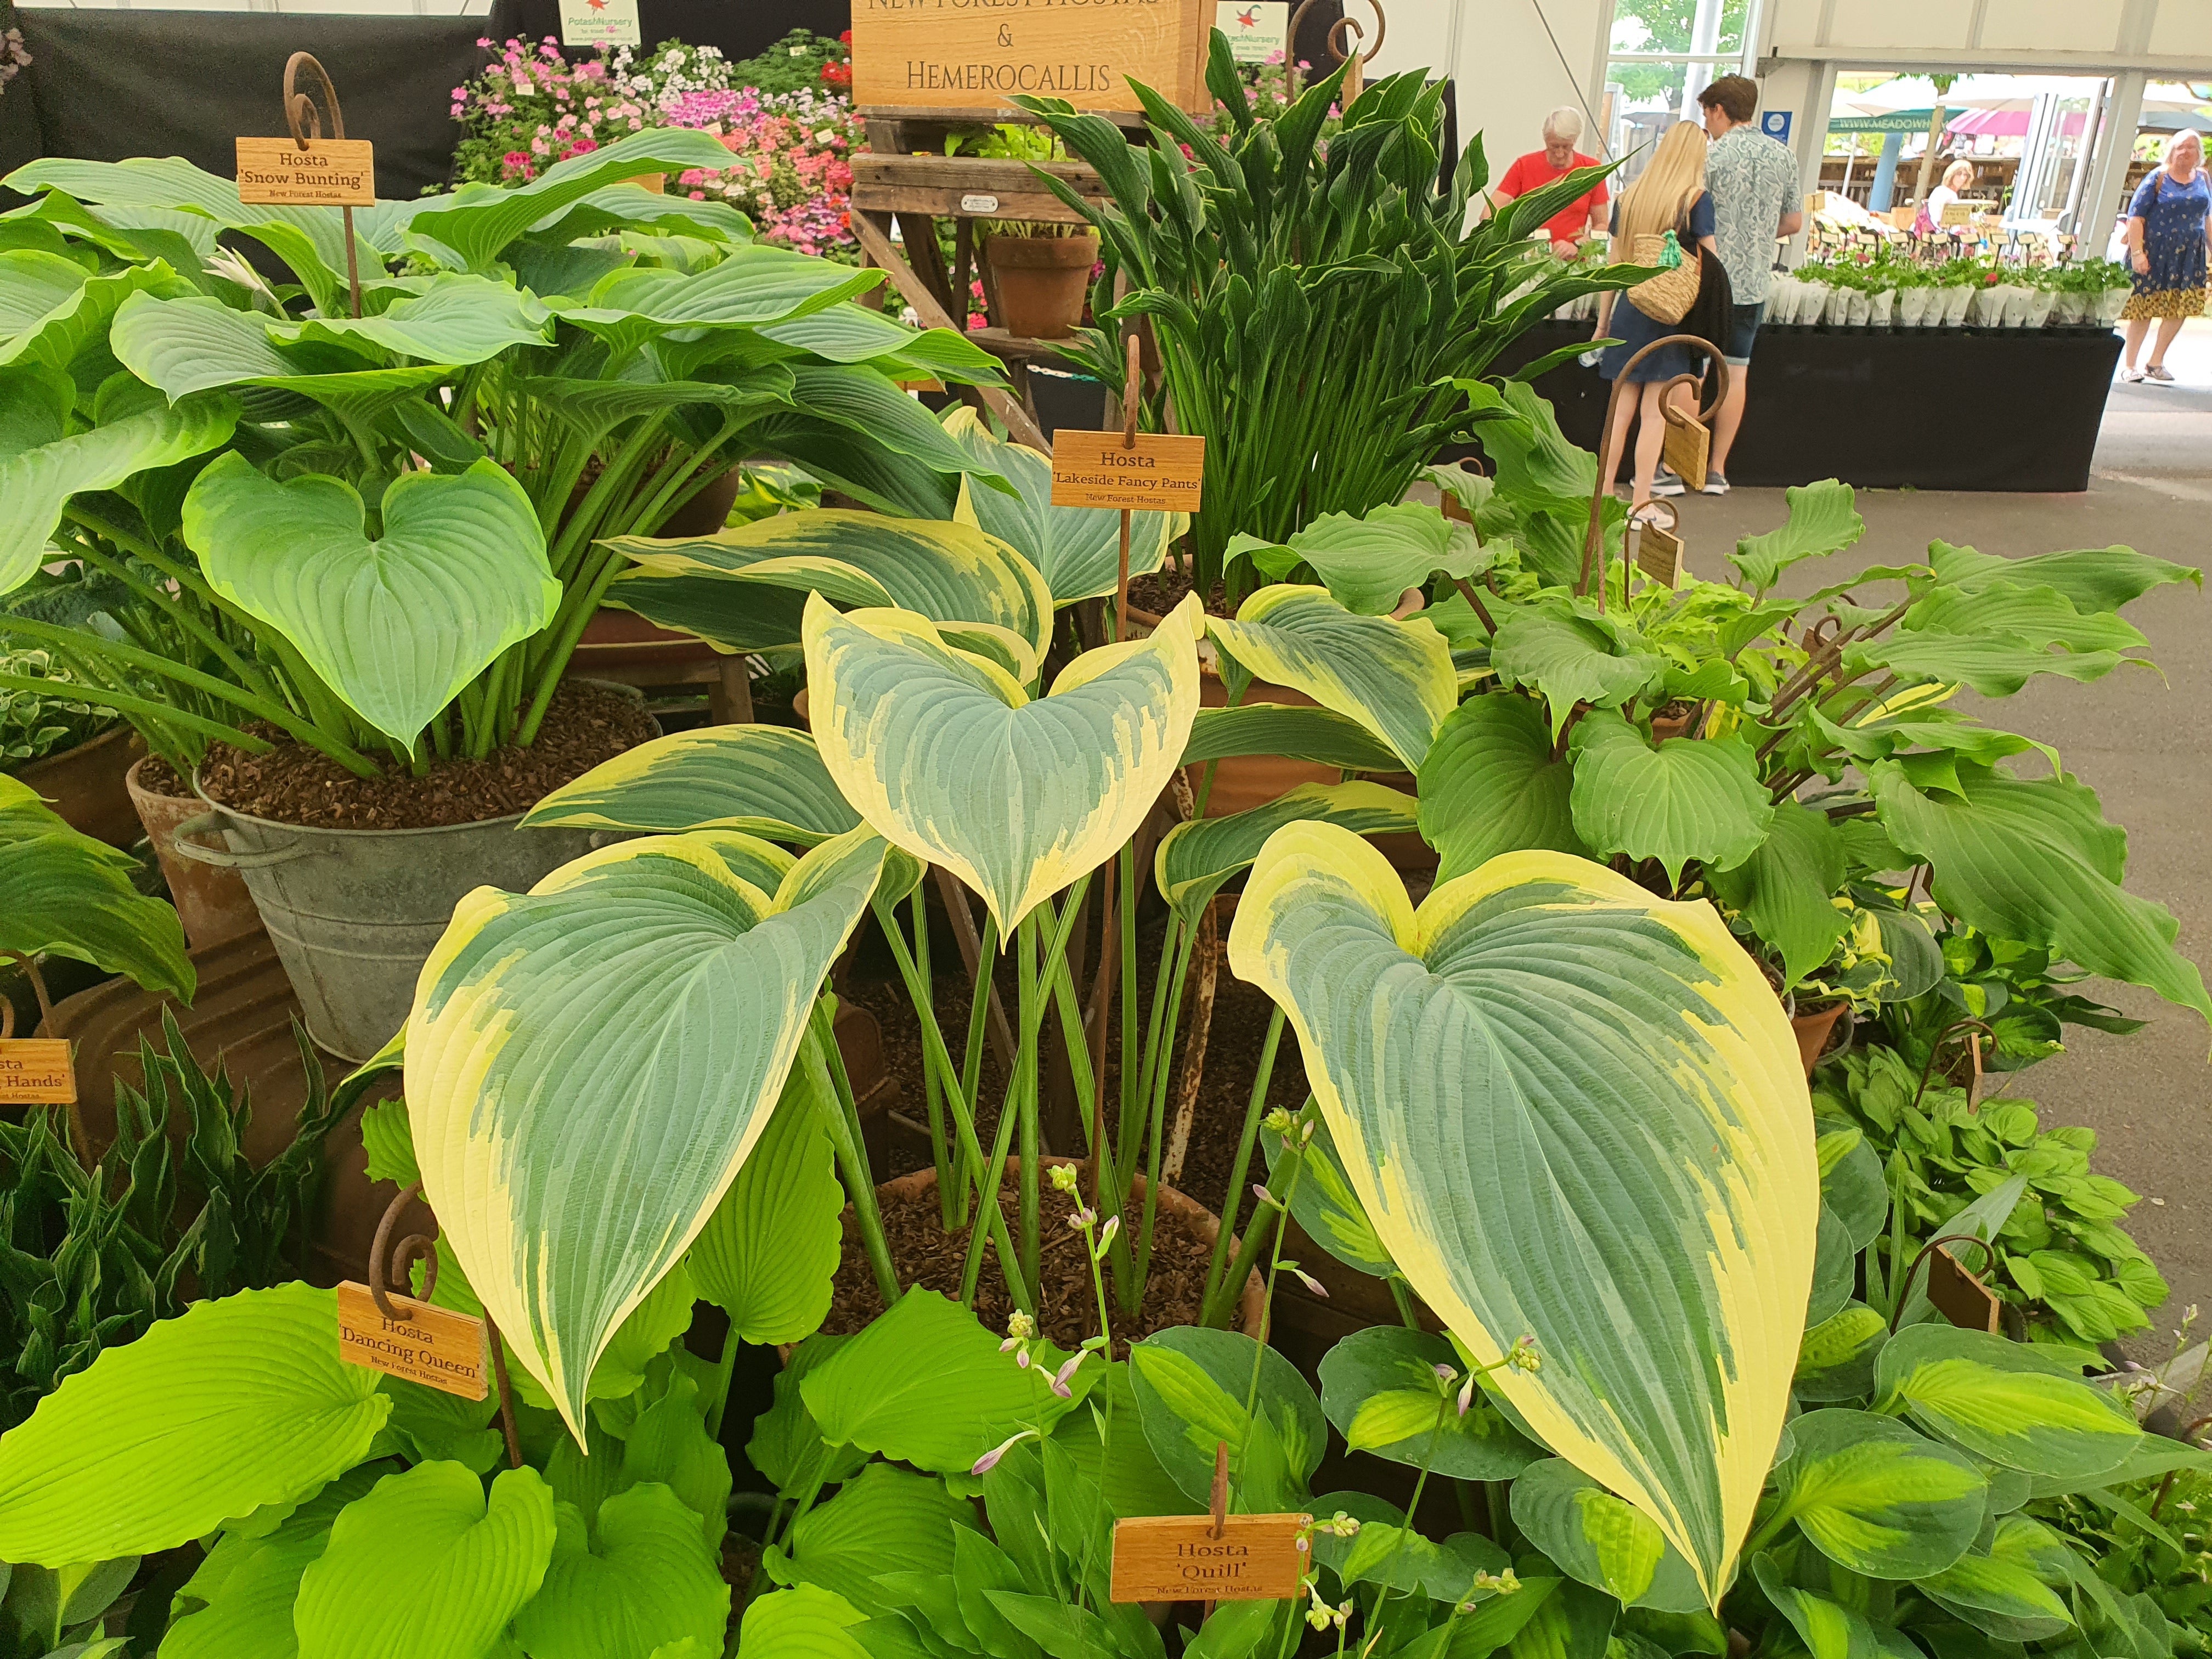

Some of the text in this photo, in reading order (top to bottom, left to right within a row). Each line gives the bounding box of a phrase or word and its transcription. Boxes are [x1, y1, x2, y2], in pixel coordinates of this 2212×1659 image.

[997, 23, 1014, 47] &
[906, 61, 1110, 92] HEMEROCALLIS
[280, 153, 329, 166] Hosta
[240, 170, 364, 190] 'Snow Bunting'
[1100, 452, 1155, 468] Hosta
[1053, 471, 1201, 490] 'Lakeside Fancy Pants'
[1086, 493, 1166, 504] New Forest Hostas
[5, 1074, 65, 1087] Hands'
[381, 1316, 434, 1345] Hosta
[339, 1324, 480, 1378] 'Dancing Queen'
[371, 1356, 390, 1368] New
[419, 1370, 447, 1384] Hostas
[1178, 1543, 1249, 1558] Hosta
